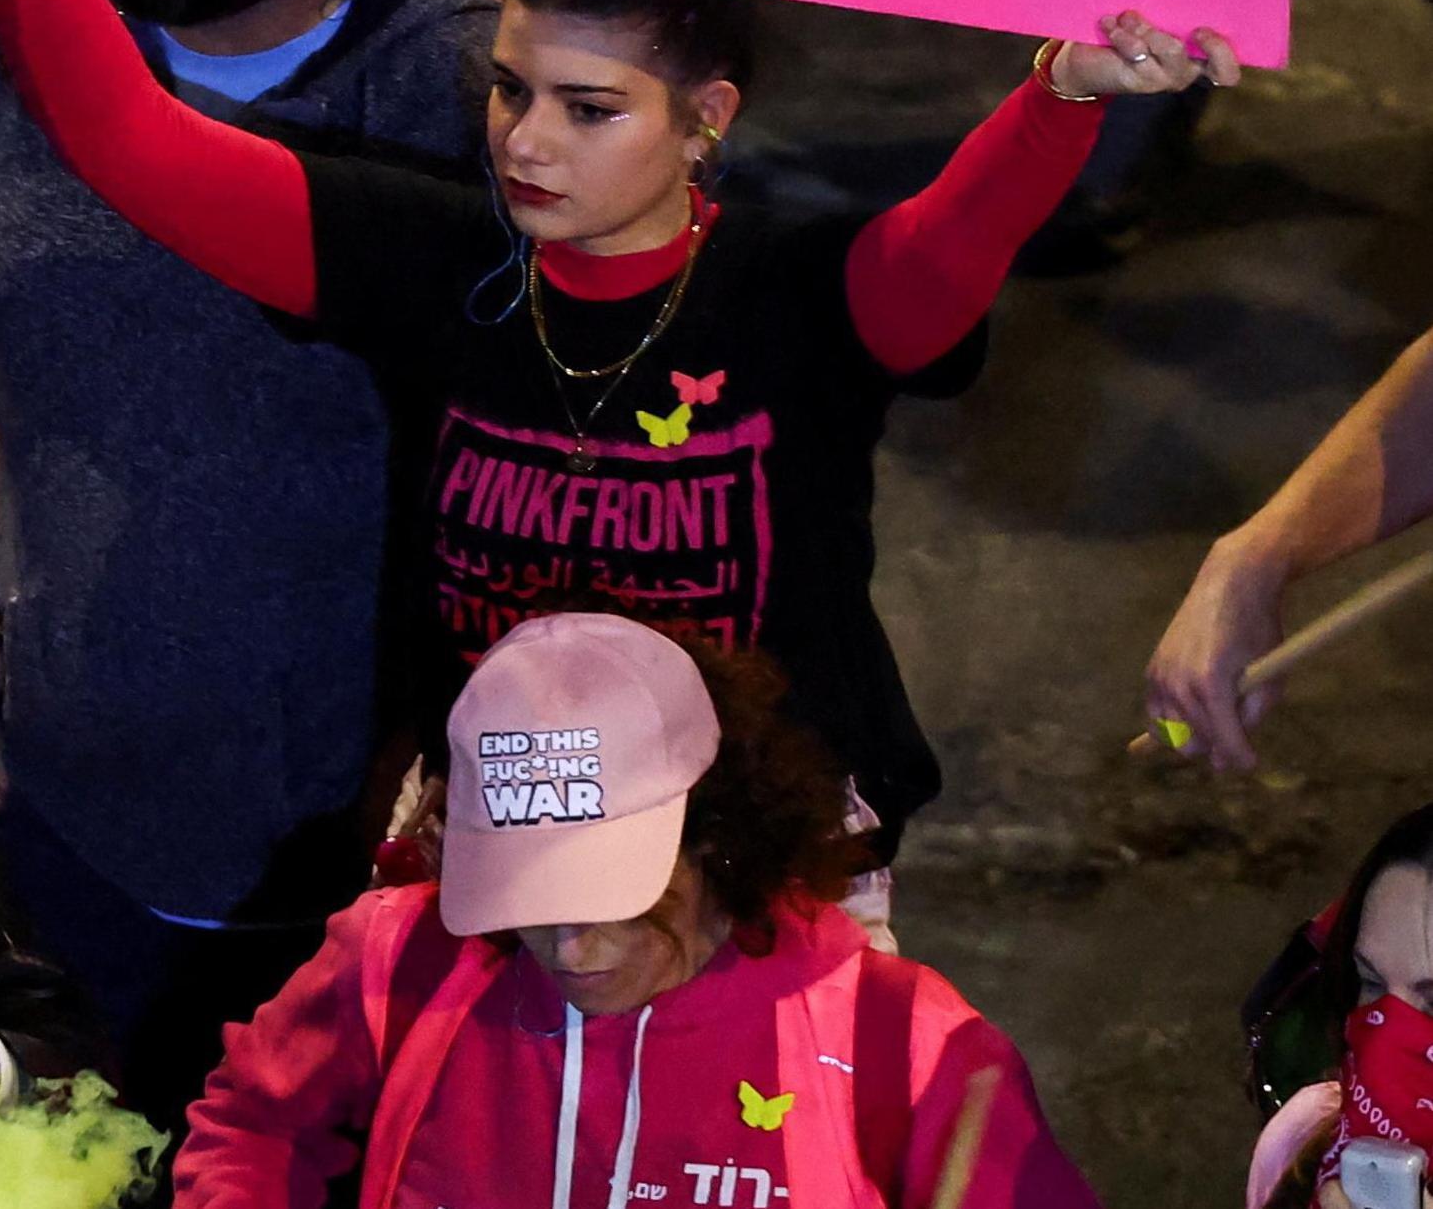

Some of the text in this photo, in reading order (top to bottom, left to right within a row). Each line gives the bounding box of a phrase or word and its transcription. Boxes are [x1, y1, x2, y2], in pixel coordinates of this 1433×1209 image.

[440, 447, 738, 552] PINKFRONT
[479, 728, 600, 758] END THIS
[482, 778, 606, 828] WAR
